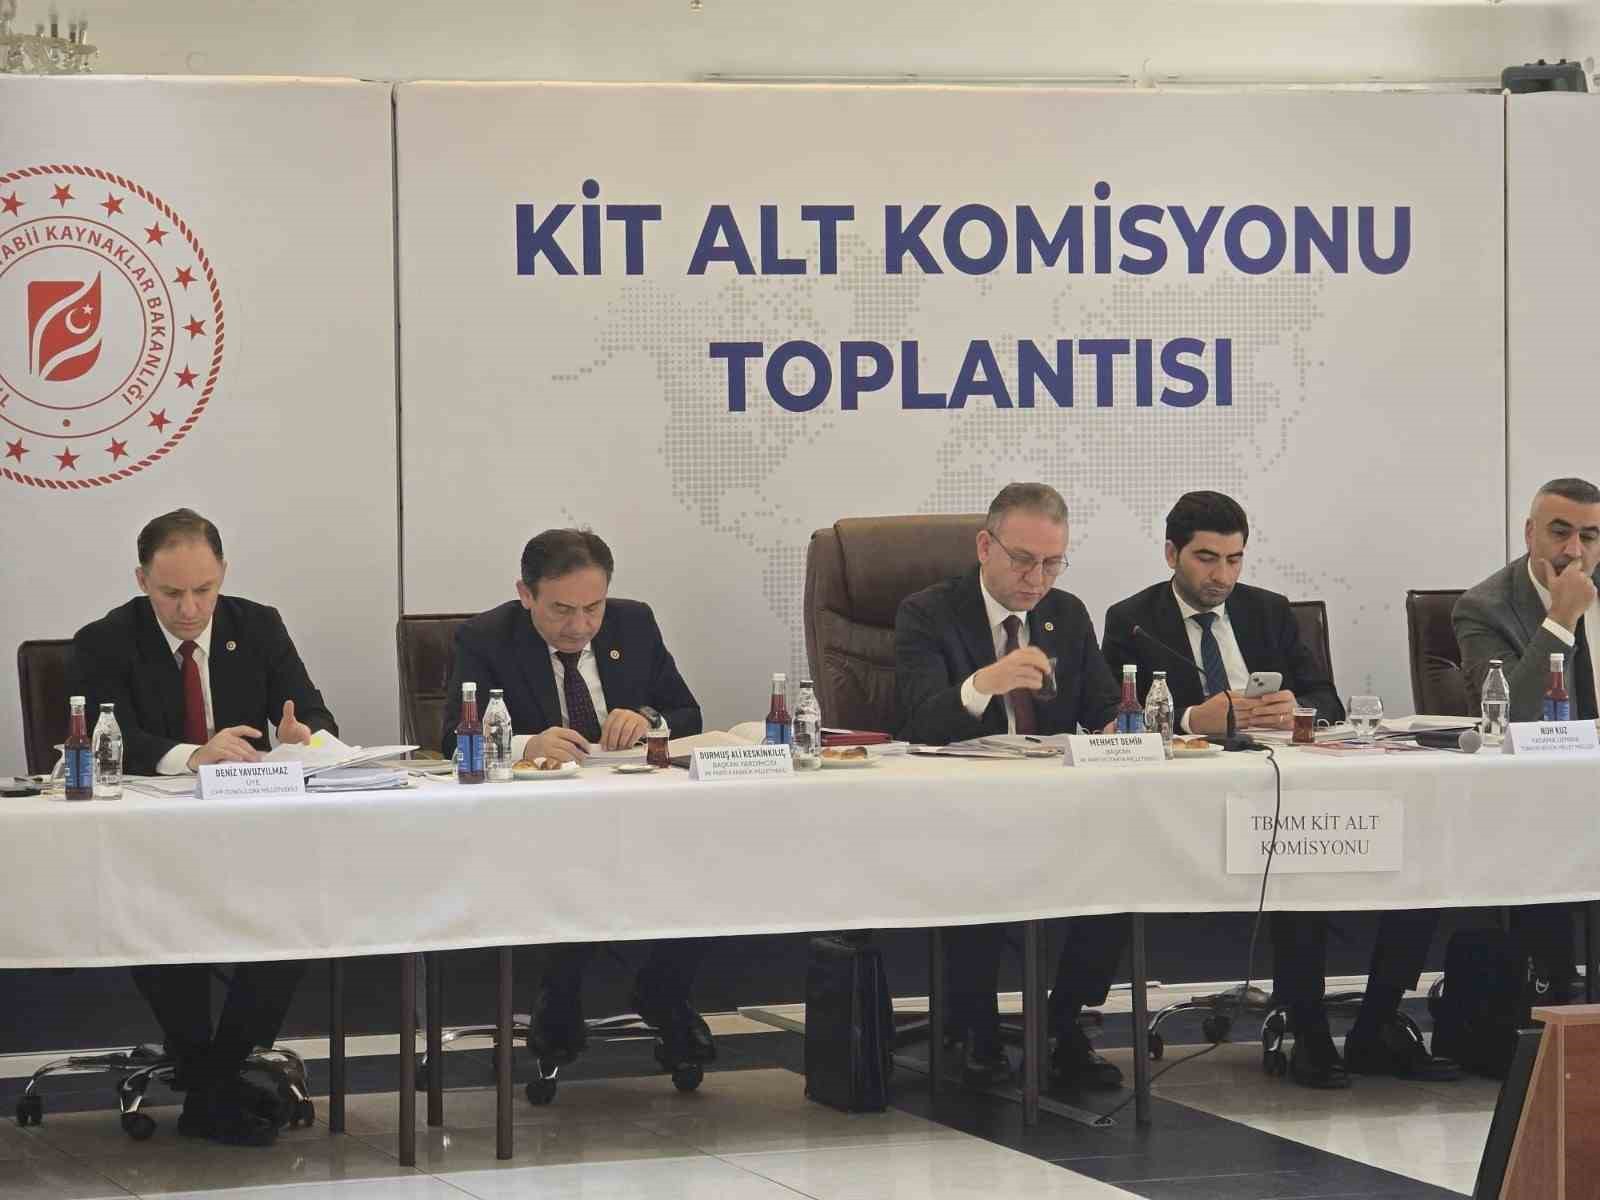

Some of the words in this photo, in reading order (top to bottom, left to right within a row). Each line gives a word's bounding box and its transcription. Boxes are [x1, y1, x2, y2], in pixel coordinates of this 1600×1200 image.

[515, 179, 662, 275] KİT
[687, 204, 855, 275] ALT
[886, 181, 1411, 275] KOMİSYONU
[0, 226, 40, 264] ABİİ
[46, 225, 156, 292] KAYNAKLAR
[121, 297, 167, 406] BAKANLIĞI
[709, 337, 1233, 412] TOPLANTISI
[1089, 737, 1118, 747] MEHMET
[700, 750, 730, 761] DURMUŞ
[731, 748, 742, 760] ALİ
[215, 766, 238, 777] DENİZ
[239, 766, 289, 777] YAVUZYILMAZ
[1250, 815, 1306, 831] TBMM
[1311, 812, 1341, 830] KİT
[1345, 815, 1381, 830] ALT
[1261, 836, 1370, 855] KOMİSYONU
